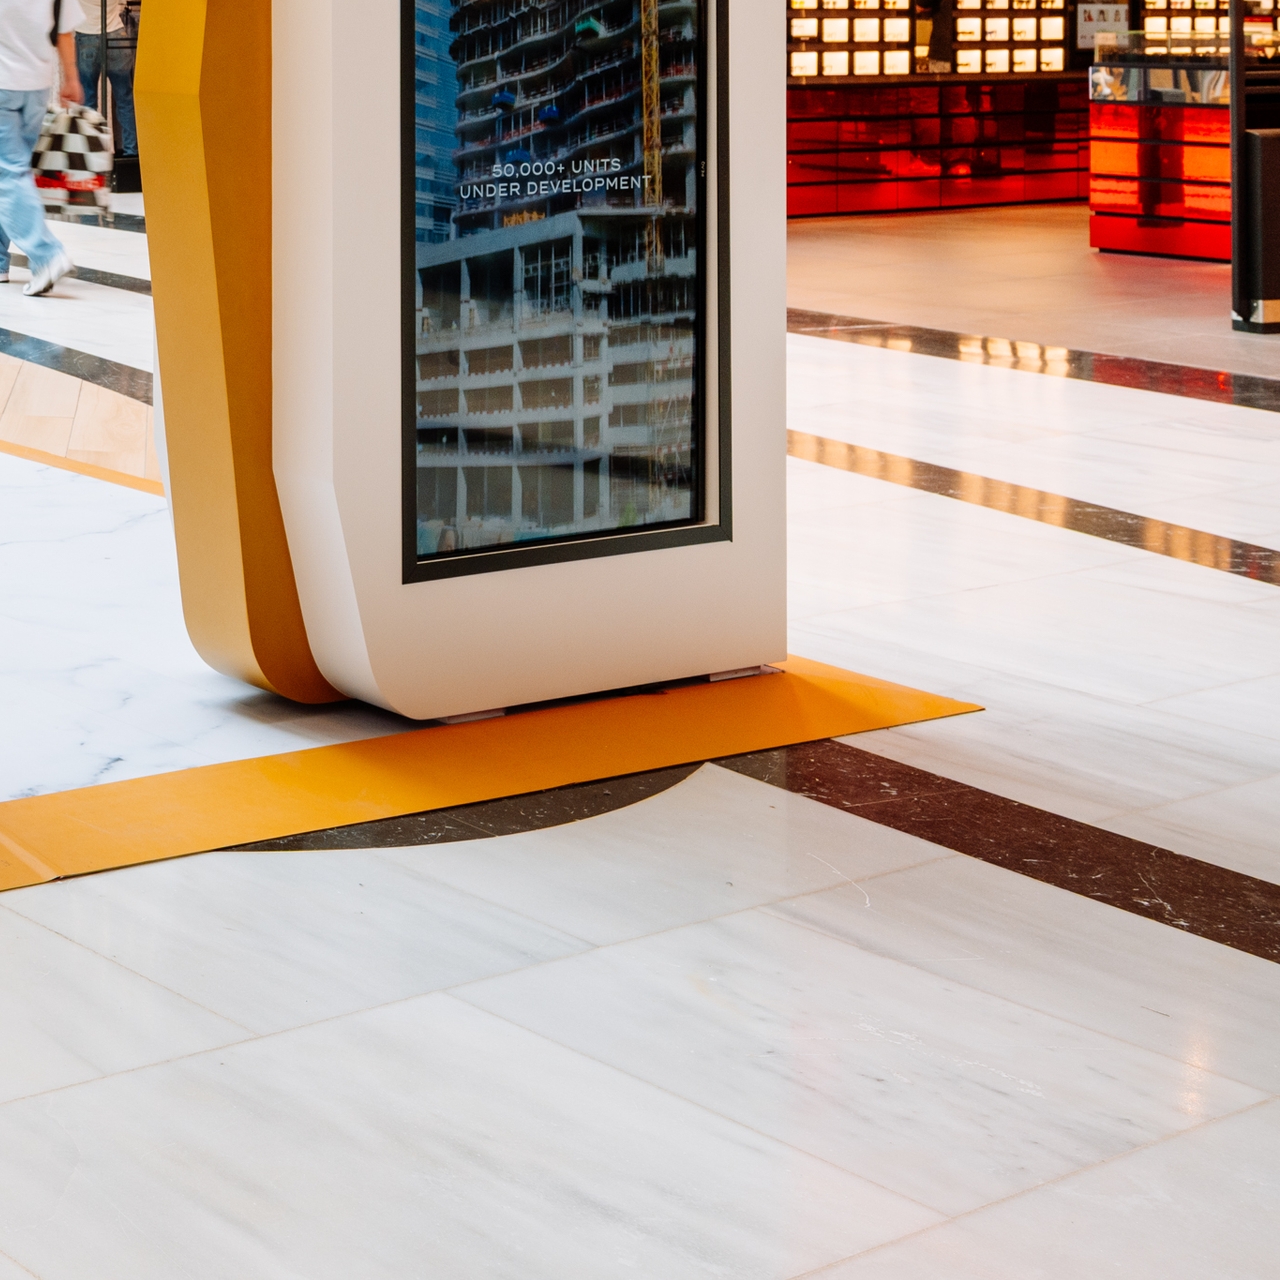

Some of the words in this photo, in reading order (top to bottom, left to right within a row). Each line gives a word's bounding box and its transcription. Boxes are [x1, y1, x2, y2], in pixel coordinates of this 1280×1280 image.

[492, 161, 565, 179] 50,000+
[572, 158, 621, 174] UNITS
[460, 183, 520, 199] UNDER
[527, 175, 651, 195] DEVELOPMENT
